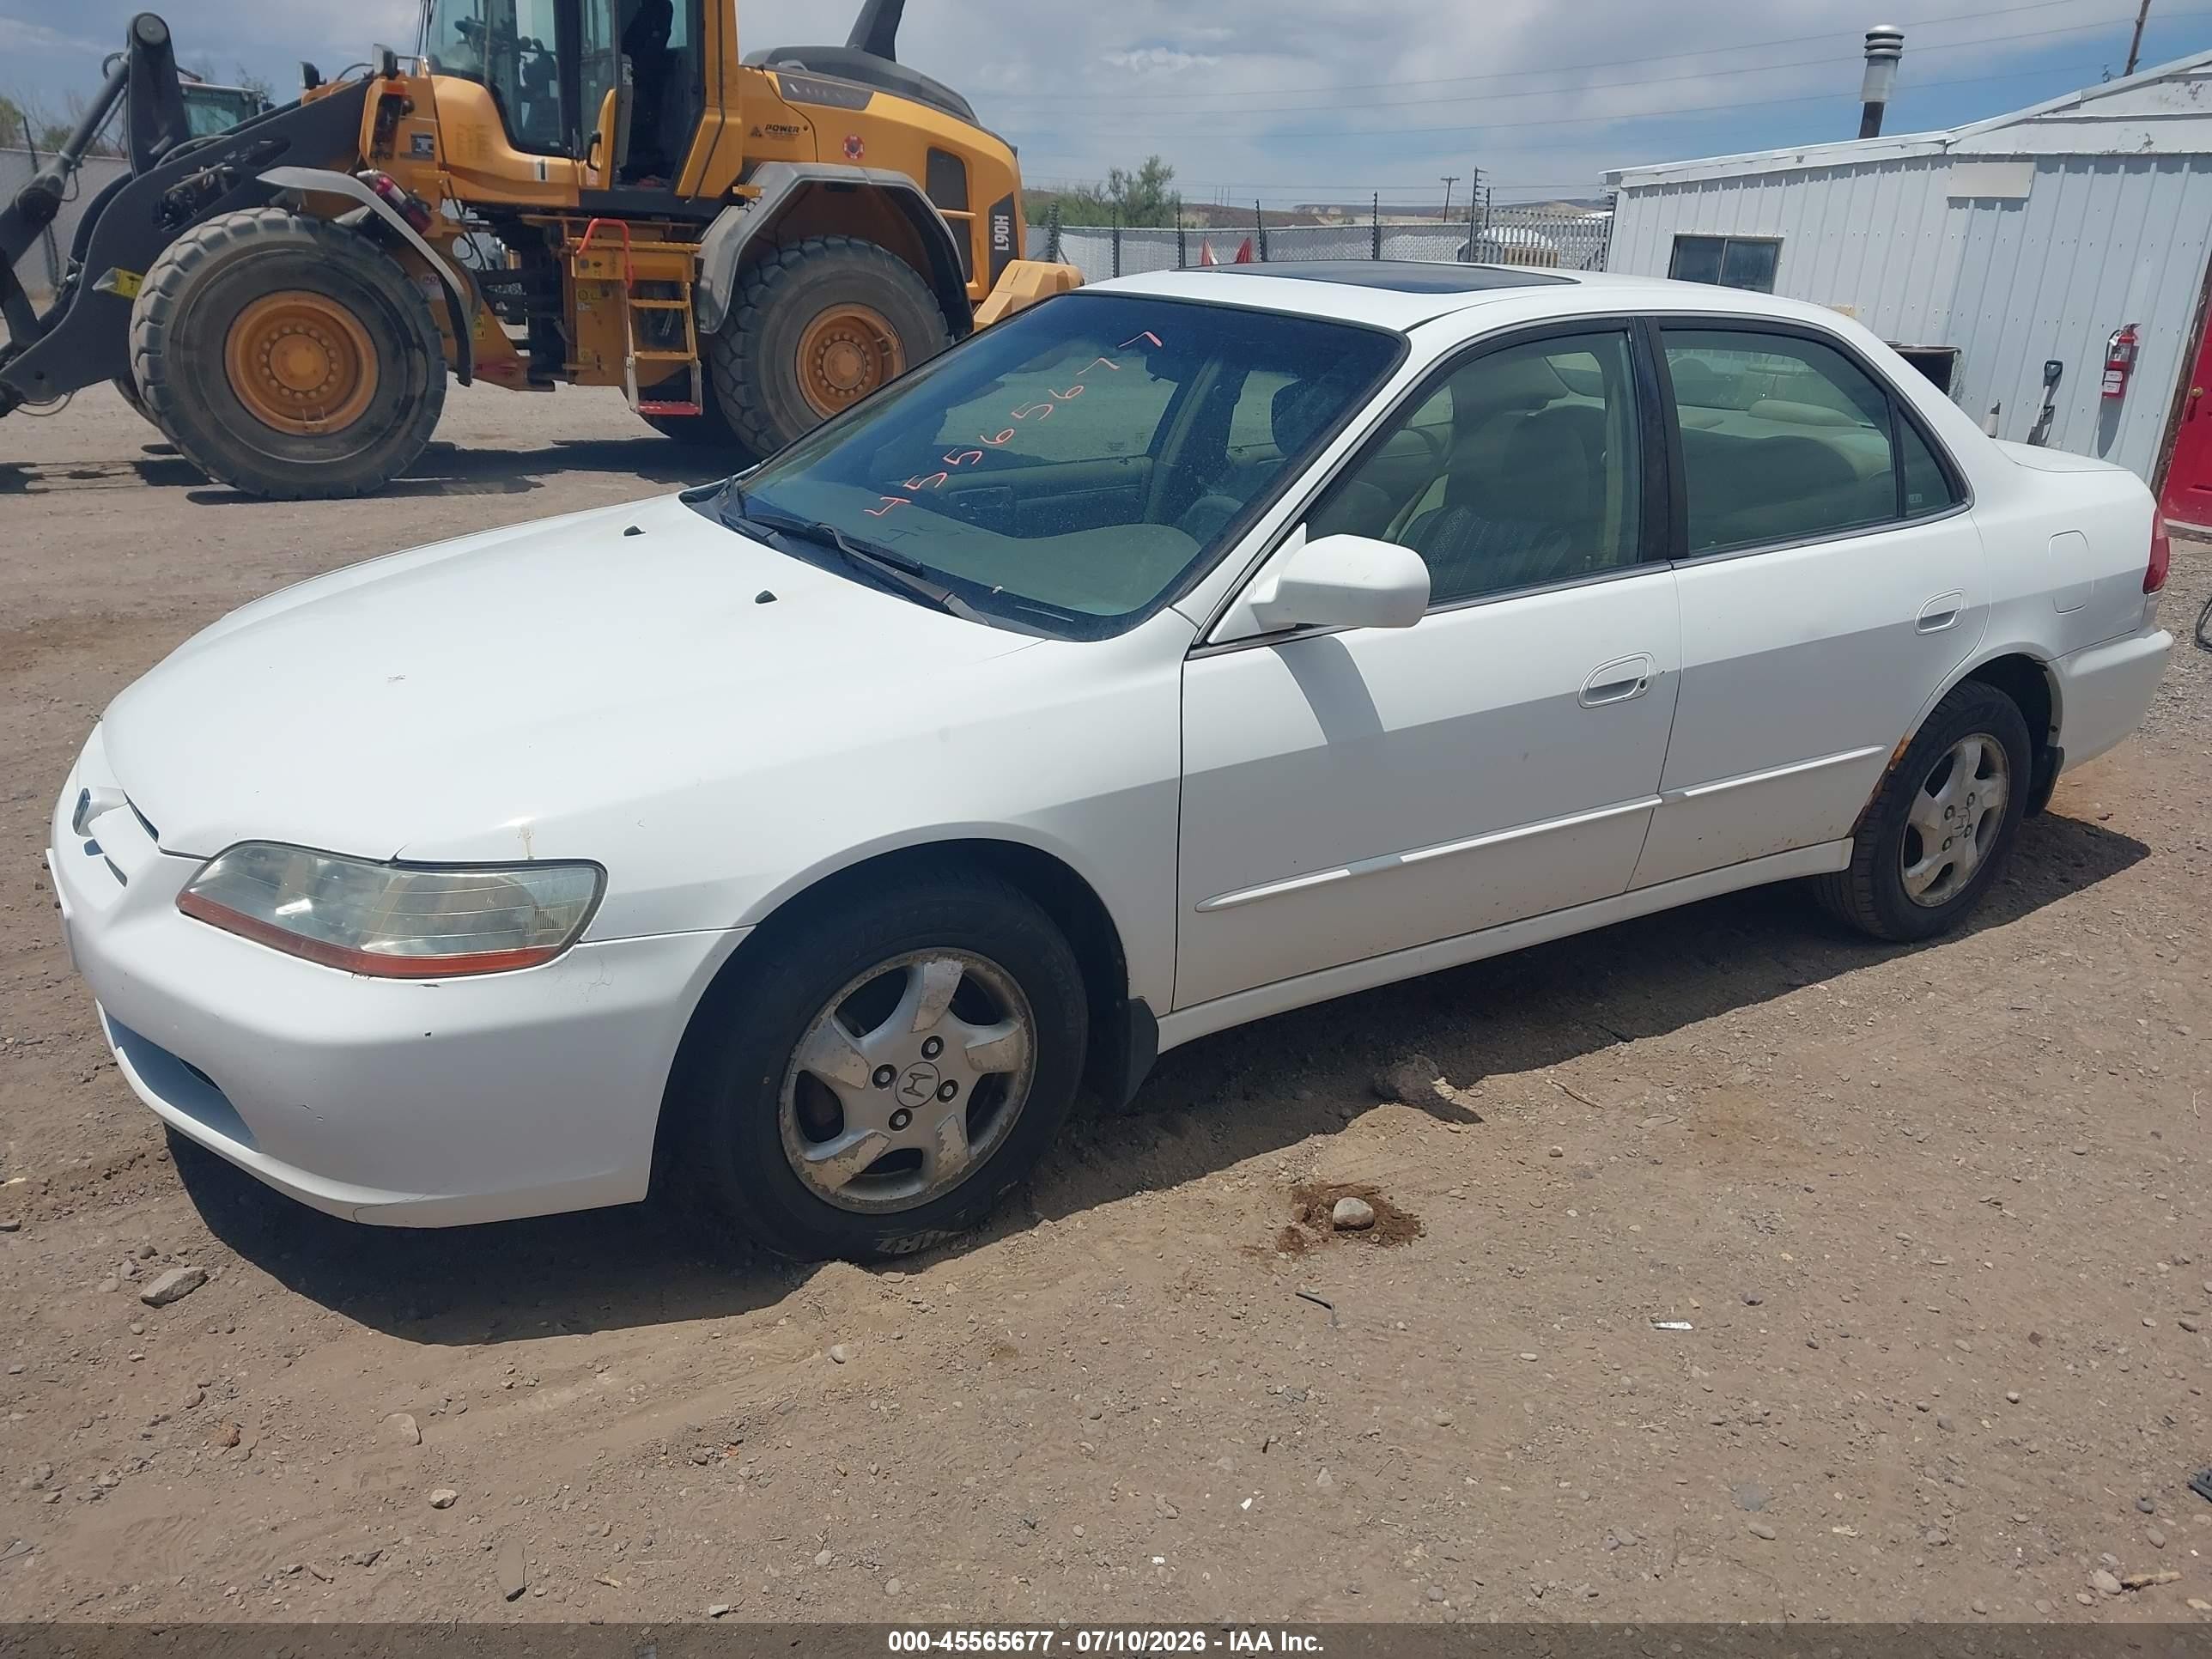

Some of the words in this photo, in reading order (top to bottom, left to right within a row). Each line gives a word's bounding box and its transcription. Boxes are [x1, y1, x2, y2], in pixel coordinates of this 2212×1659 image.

[764, 124, 800, 133] POWER
[994, 215, 1010, 251] L90H
[863, 331, 1163, 516] 45565677
